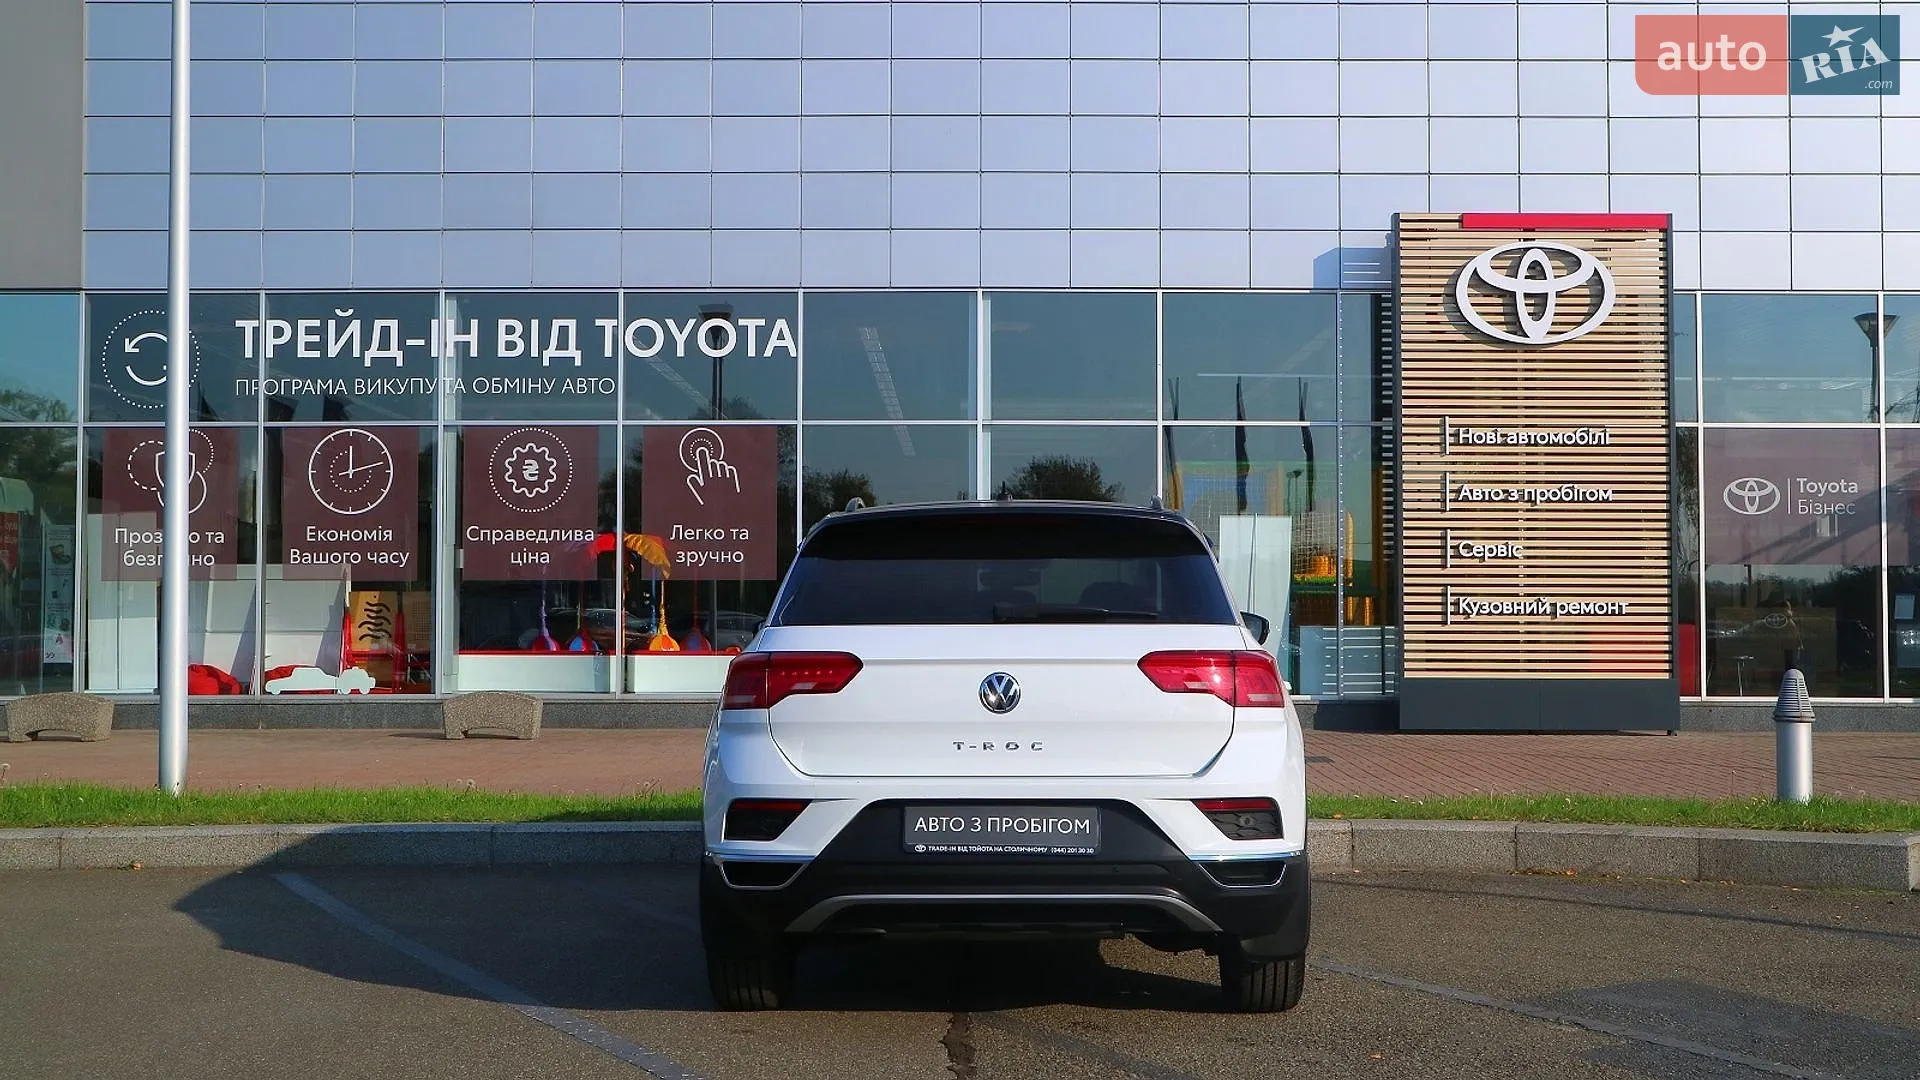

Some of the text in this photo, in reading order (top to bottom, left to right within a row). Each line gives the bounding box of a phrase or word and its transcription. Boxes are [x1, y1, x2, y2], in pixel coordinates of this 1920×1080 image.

[235, 308, 798, 367] ТРЕЙД-ІН ВІД TOYOTA
[235, 377, 616, 396] ПРОГРАМА ВИКУПУ ТА ОБМІНУ АВТО
[1459, 428, 1610, 445] Нові автомобілі
[1458, 484, 1504, 501] Авто
[1524, 484, 1613, 504] пробігом
[1797, 478, 1859, 496] Toyota
[1798, 499, 1856, 516] Бізнес
[115, 527, 225, 547] Прозо та
[306, 525, 393, 541] Економія
[466, 525, 595, 544] Справедлива
[669, 524, 749, 541] Легко та
[290, 548, 410, 568] Вашого часу
[510, 547, 551, 566] ціна
[675, 550, 745, 567] зручно
[1459, 541, 1524, 561] Сервіс
[1459, 596, 1629, 617] Кузовний ремонт
[952, 741, 1044, 751] T-ROC
[914, 816, 965, 833] АВТО
[987, 816, 1091, 835] ПРОБІГОМ
